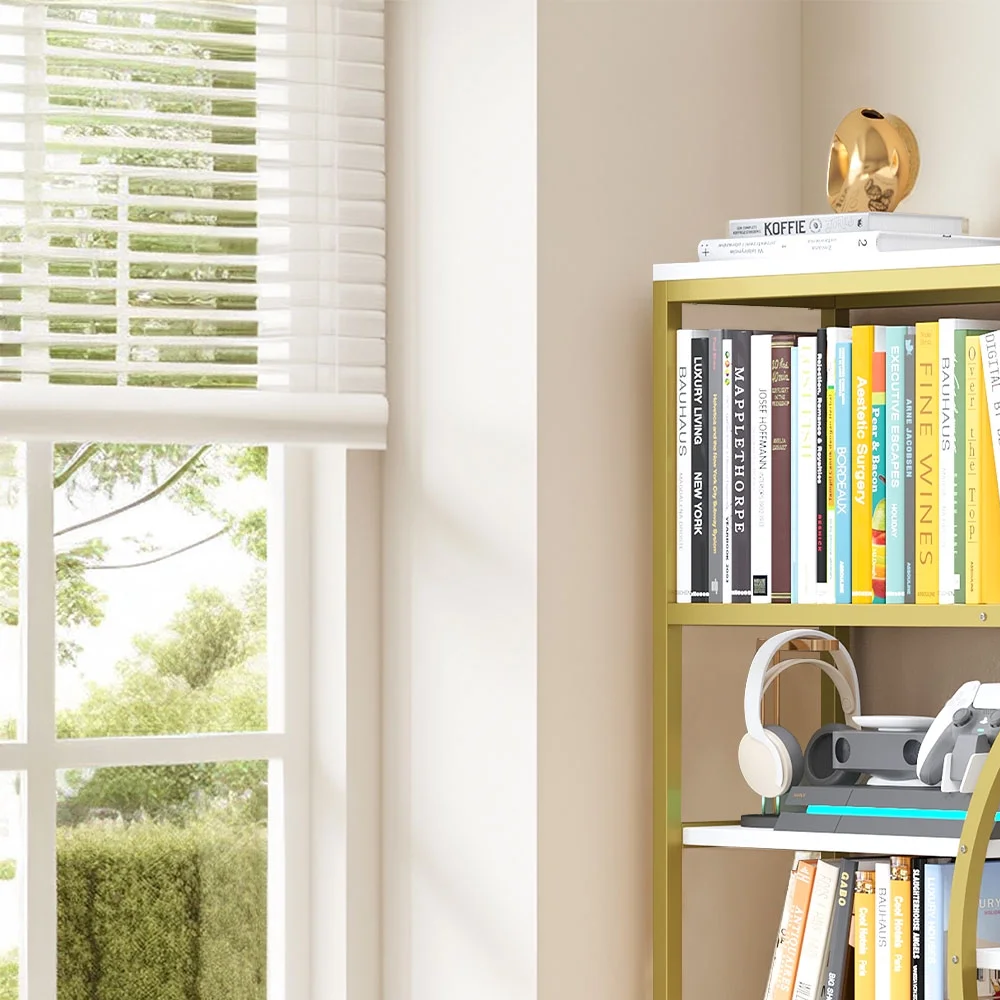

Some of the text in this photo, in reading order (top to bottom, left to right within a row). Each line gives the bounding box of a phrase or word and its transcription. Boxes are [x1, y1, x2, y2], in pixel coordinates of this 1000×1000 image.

[764, 220, 806, 236] KOFFIE
[985, 333, 1000, 392] DIGITAL
[678, 366, 687, 456] BAUHAUS
[693, 357, 703, 445] LUXURY LIVING
[890, 345, 900, 489] EXECUTIVE ESCAPES
[941, 357, 951, 452] BAUHAUS
[734, 366, 745, 533] MAPPLETHORPE
[759, 416, 768, 470] HOFFMANN
[872, 454, 880, 492] Bacon
[919, 363, 933, 565] FINE WINES
[693, 472, 703, 535] NEW YORK
[837, 446, 847, 515] BORDEAUX
[855, 443, 868, 505] Surgery
[890, 503, 899, 538] HOLIDAY
[838, 871, 850, 907] GABO
[878, 887, 887, 948] BAUHAUS
[978, 898, 1000, 909] URY
[781, 904, 804, 993] ANTIQUAIRES
[912, 932, 920, 959] ANGELS
[827, 971, 837, 987] BIG
